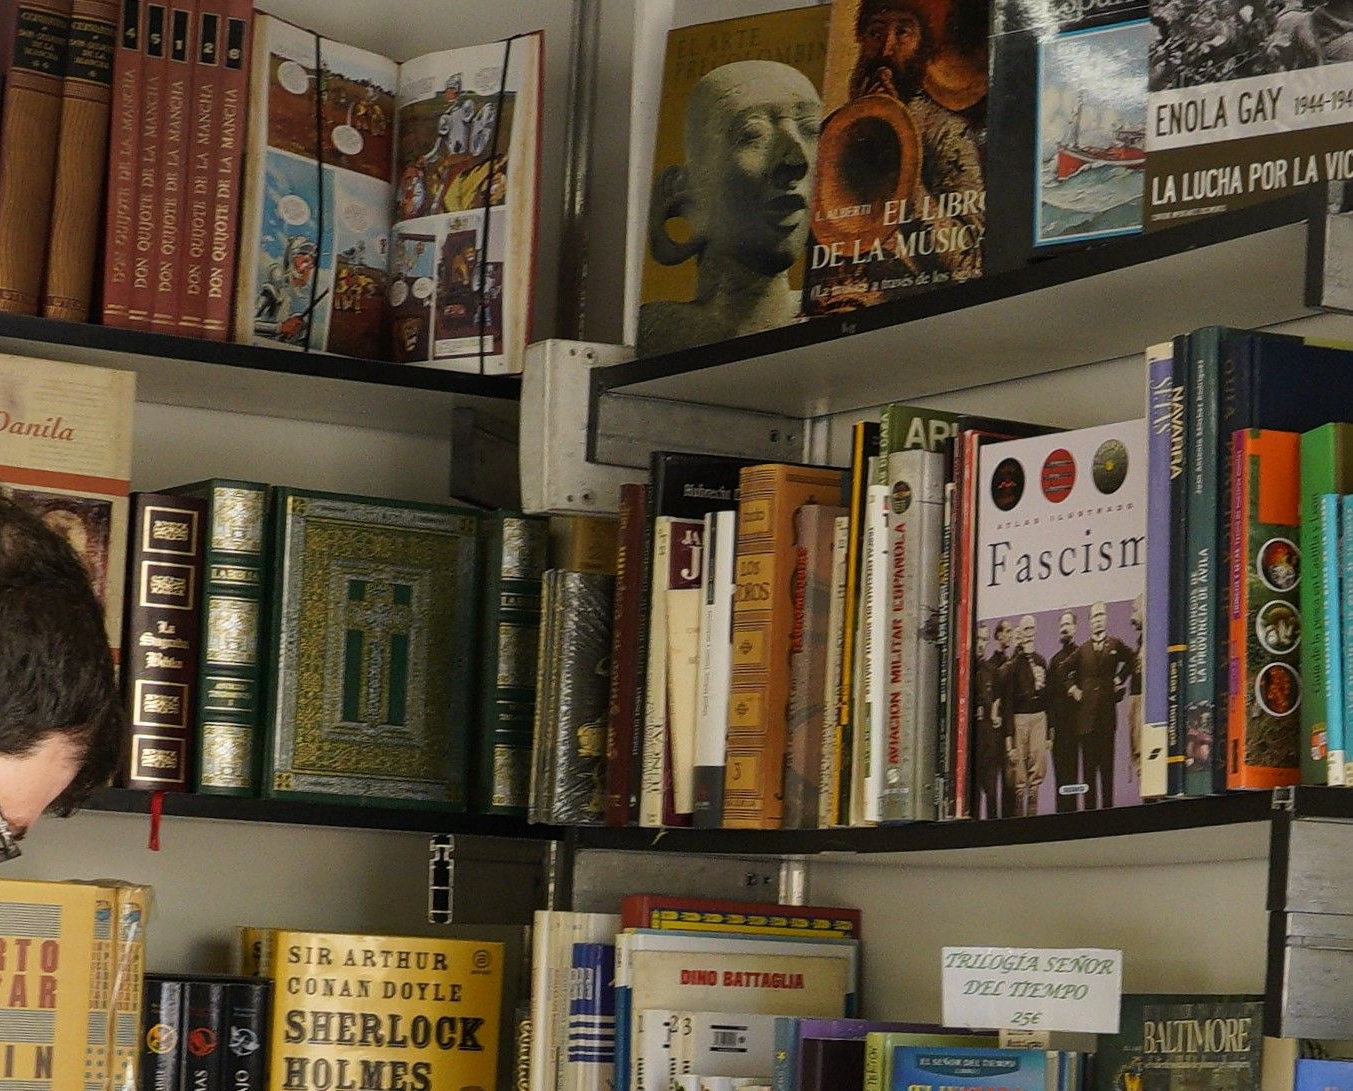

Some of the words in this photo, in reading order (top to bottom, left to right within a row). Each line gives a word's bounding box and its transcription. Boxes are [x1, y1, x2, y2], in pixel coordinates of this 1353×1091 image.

[204, 42, 215, 54] 2
[145, 76, 158, 138] MANCHA
[168, 80, 183, 141] MANCHA
[197, 84, 213, 145] MANCHA
[221, 88, 238, 149] MANCHA
[1155, 95, 1228, 138] ENOLA
[1238, 86, 1283, 126] GAY
[144, 145, 156, 163] LA
[167, 150, 179, 168] LA
[196, 152, 208, 170] LA
[220, 156, 233, 174] LA
[141, 168, 155, 188] DE
[165, 172, 178, 192] DE
[194, 176, 206, 195] DE
[217, 179, 231, 198] DE
[1151, 171, 1177, 207] LA
[1182, 164, 1244, 201] LUCHA
[1249, 157, 1287, 193] POR
[1292, 152, 1318, 187] LA
[136, 193, 153, 252] QUIJOTE
[160, 198, 178, 256] QUIJOTE
[883, 199, 912, 225] EL
[190, 201, 206, 258] QUIJOTE
[212, 204, 229, 261] QUIJOTE
[811, 242, 845, 269] DE
[853, 238, 884, 264] LA
[133, 258, 147, 288] DON
[158, 261, 173, 292] DON
[187, 264, 202, 295] DON
[208, 267, 223, 299] DON
[890, 619, 903, 685] MILITAR
[288, 945, 332, 966] SIR
[343, 948, 448, 971] ARTHUR
[945, 951, 1041, 974] TRILOGÍA
[1043, 953, 1115, 975] SEÑOR
[287, 977, 373, 998] CONAN
[382, 981, 463, 1002] DOYLE
[679, 969, 718, 986] DINO
[721, 969, 806, 989] BATTAGLIA
[962, 979, 1004, 998] DEL
[1008, 981, 1089, 1000] TIEMPO
[284, 1009, 486, 1051] SHERLOCK
[1010, 1010, 1042, 1026] 25€
[1144, 1017, 1252, 1054] BALTIMORE
